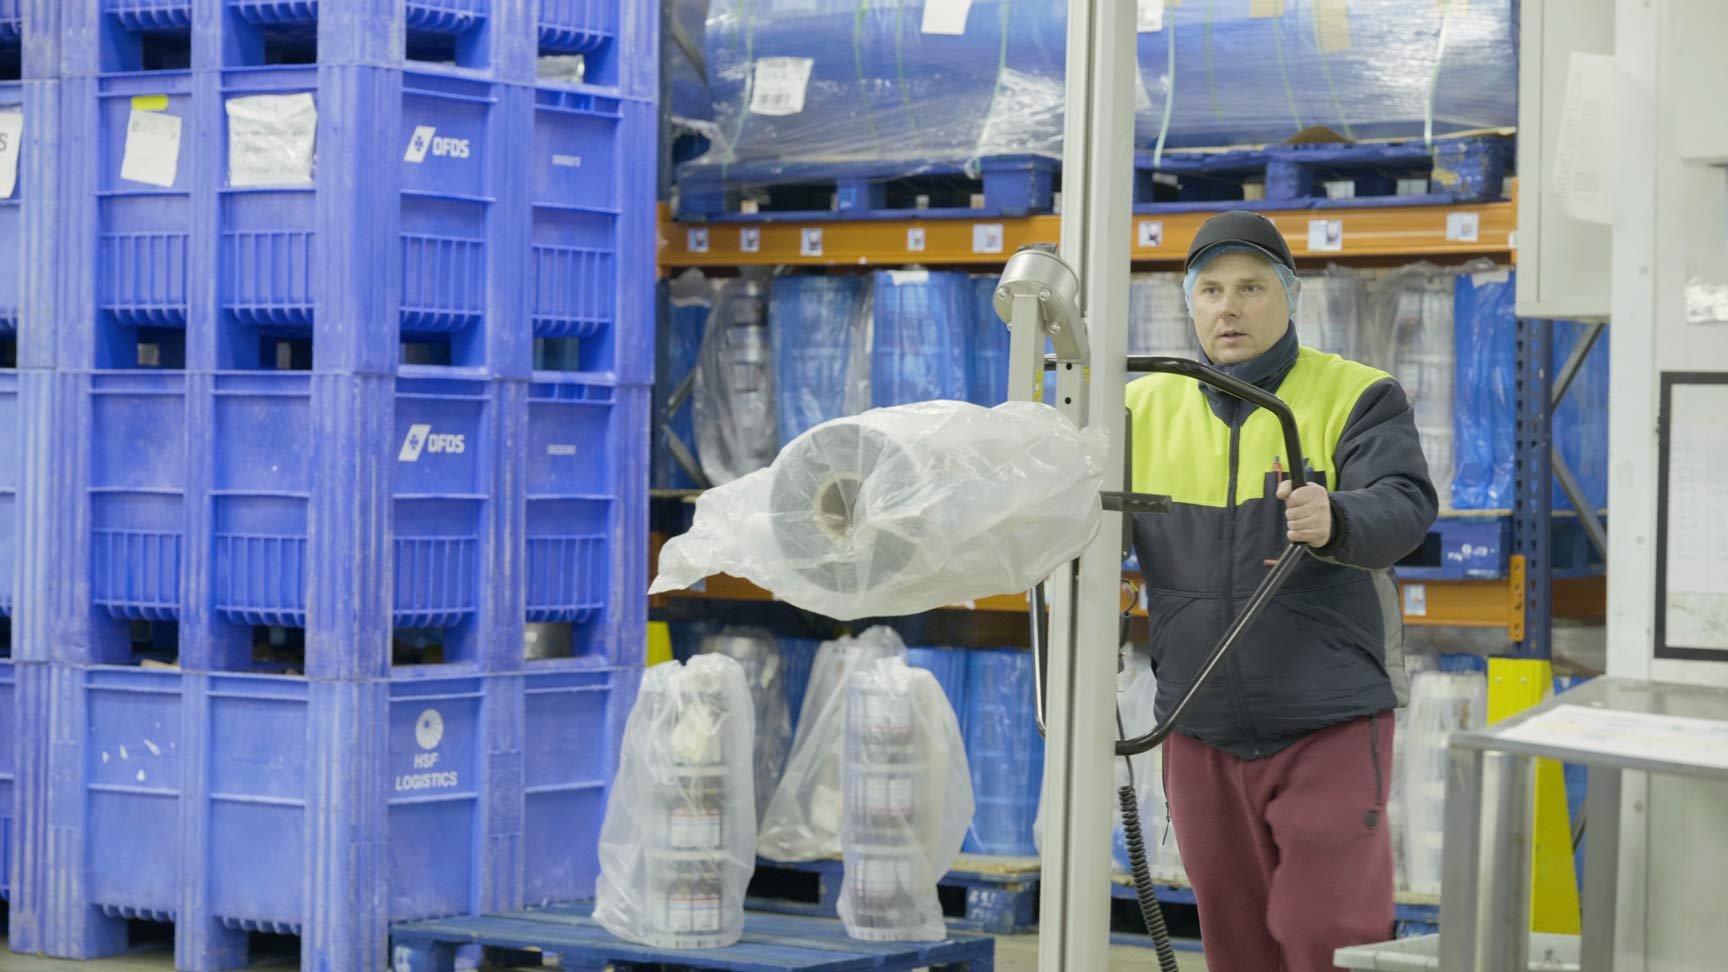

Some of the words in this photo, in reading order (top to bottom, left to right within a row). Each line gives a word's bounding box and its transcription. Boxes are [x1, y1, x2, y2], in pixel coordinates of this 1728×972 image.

[432, 136, 470, 158] DFDS
[428, 433, 465, 454] DFDS
[413, 752, 439, 768] HSF
[395, 771, 458, 791] LOGISTICS
